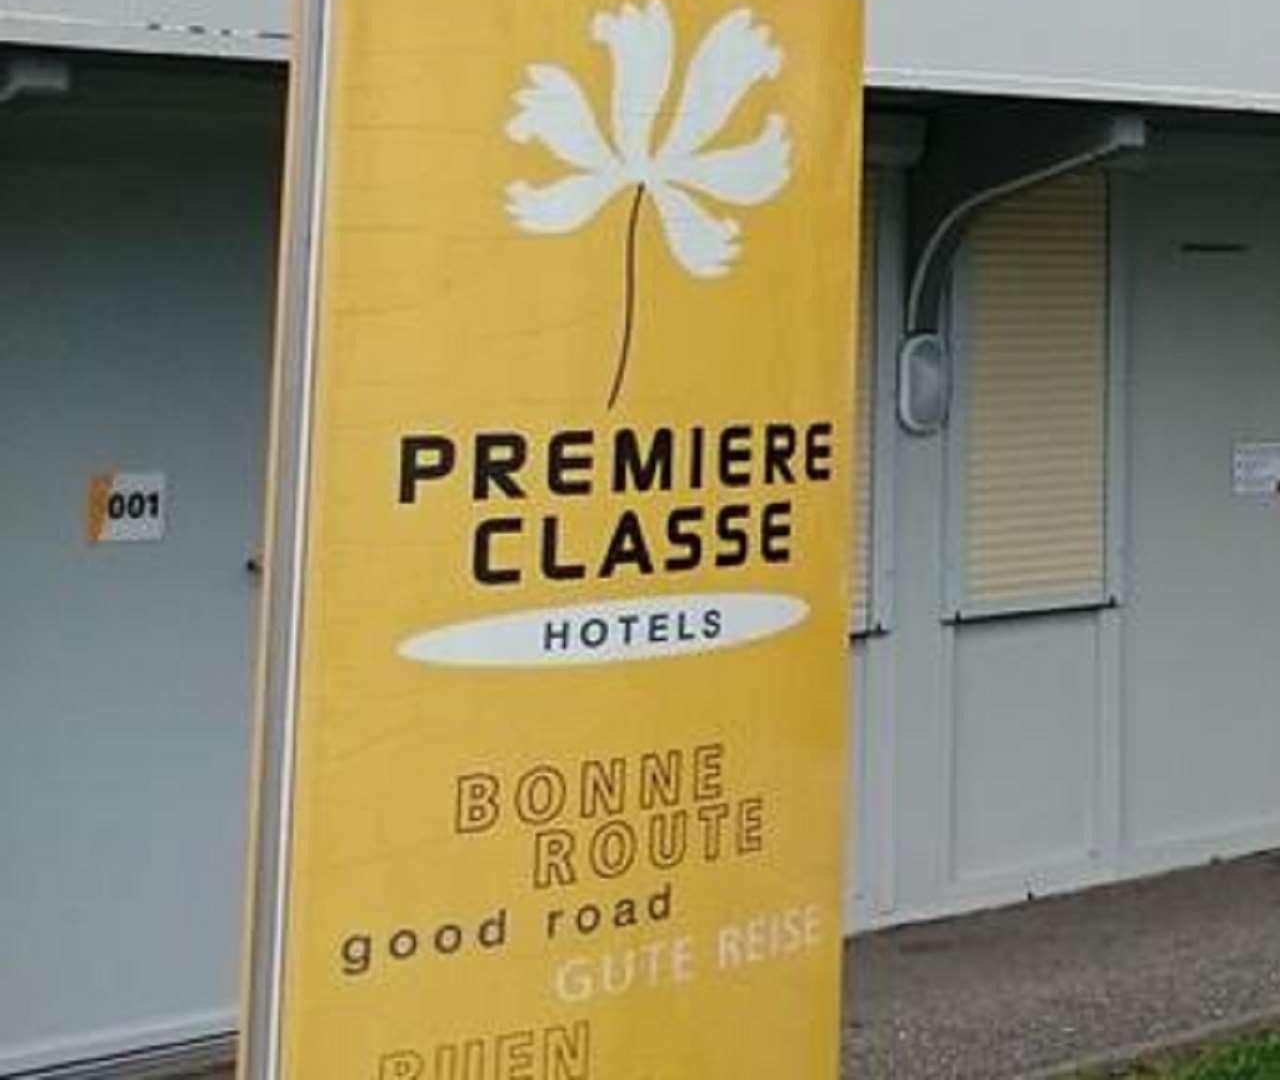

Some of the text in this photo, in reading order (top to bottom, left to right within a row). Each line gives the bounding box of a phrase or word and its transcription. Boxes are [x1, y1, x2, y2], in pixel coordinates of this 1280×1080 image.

[108, 491, 160, 520] 001
[399, 422, 834, 504] PREMIERE
[471, 501, 793, 586] CLASSE
[543, 609, 723, 651] HOTELS
[454, 743, 725, 834] BONNE
[532, 797, 765, 890] ROUTE
[339, 883, 674, 976] good road
[553, 904, 824, 1004] GUTE REISE
